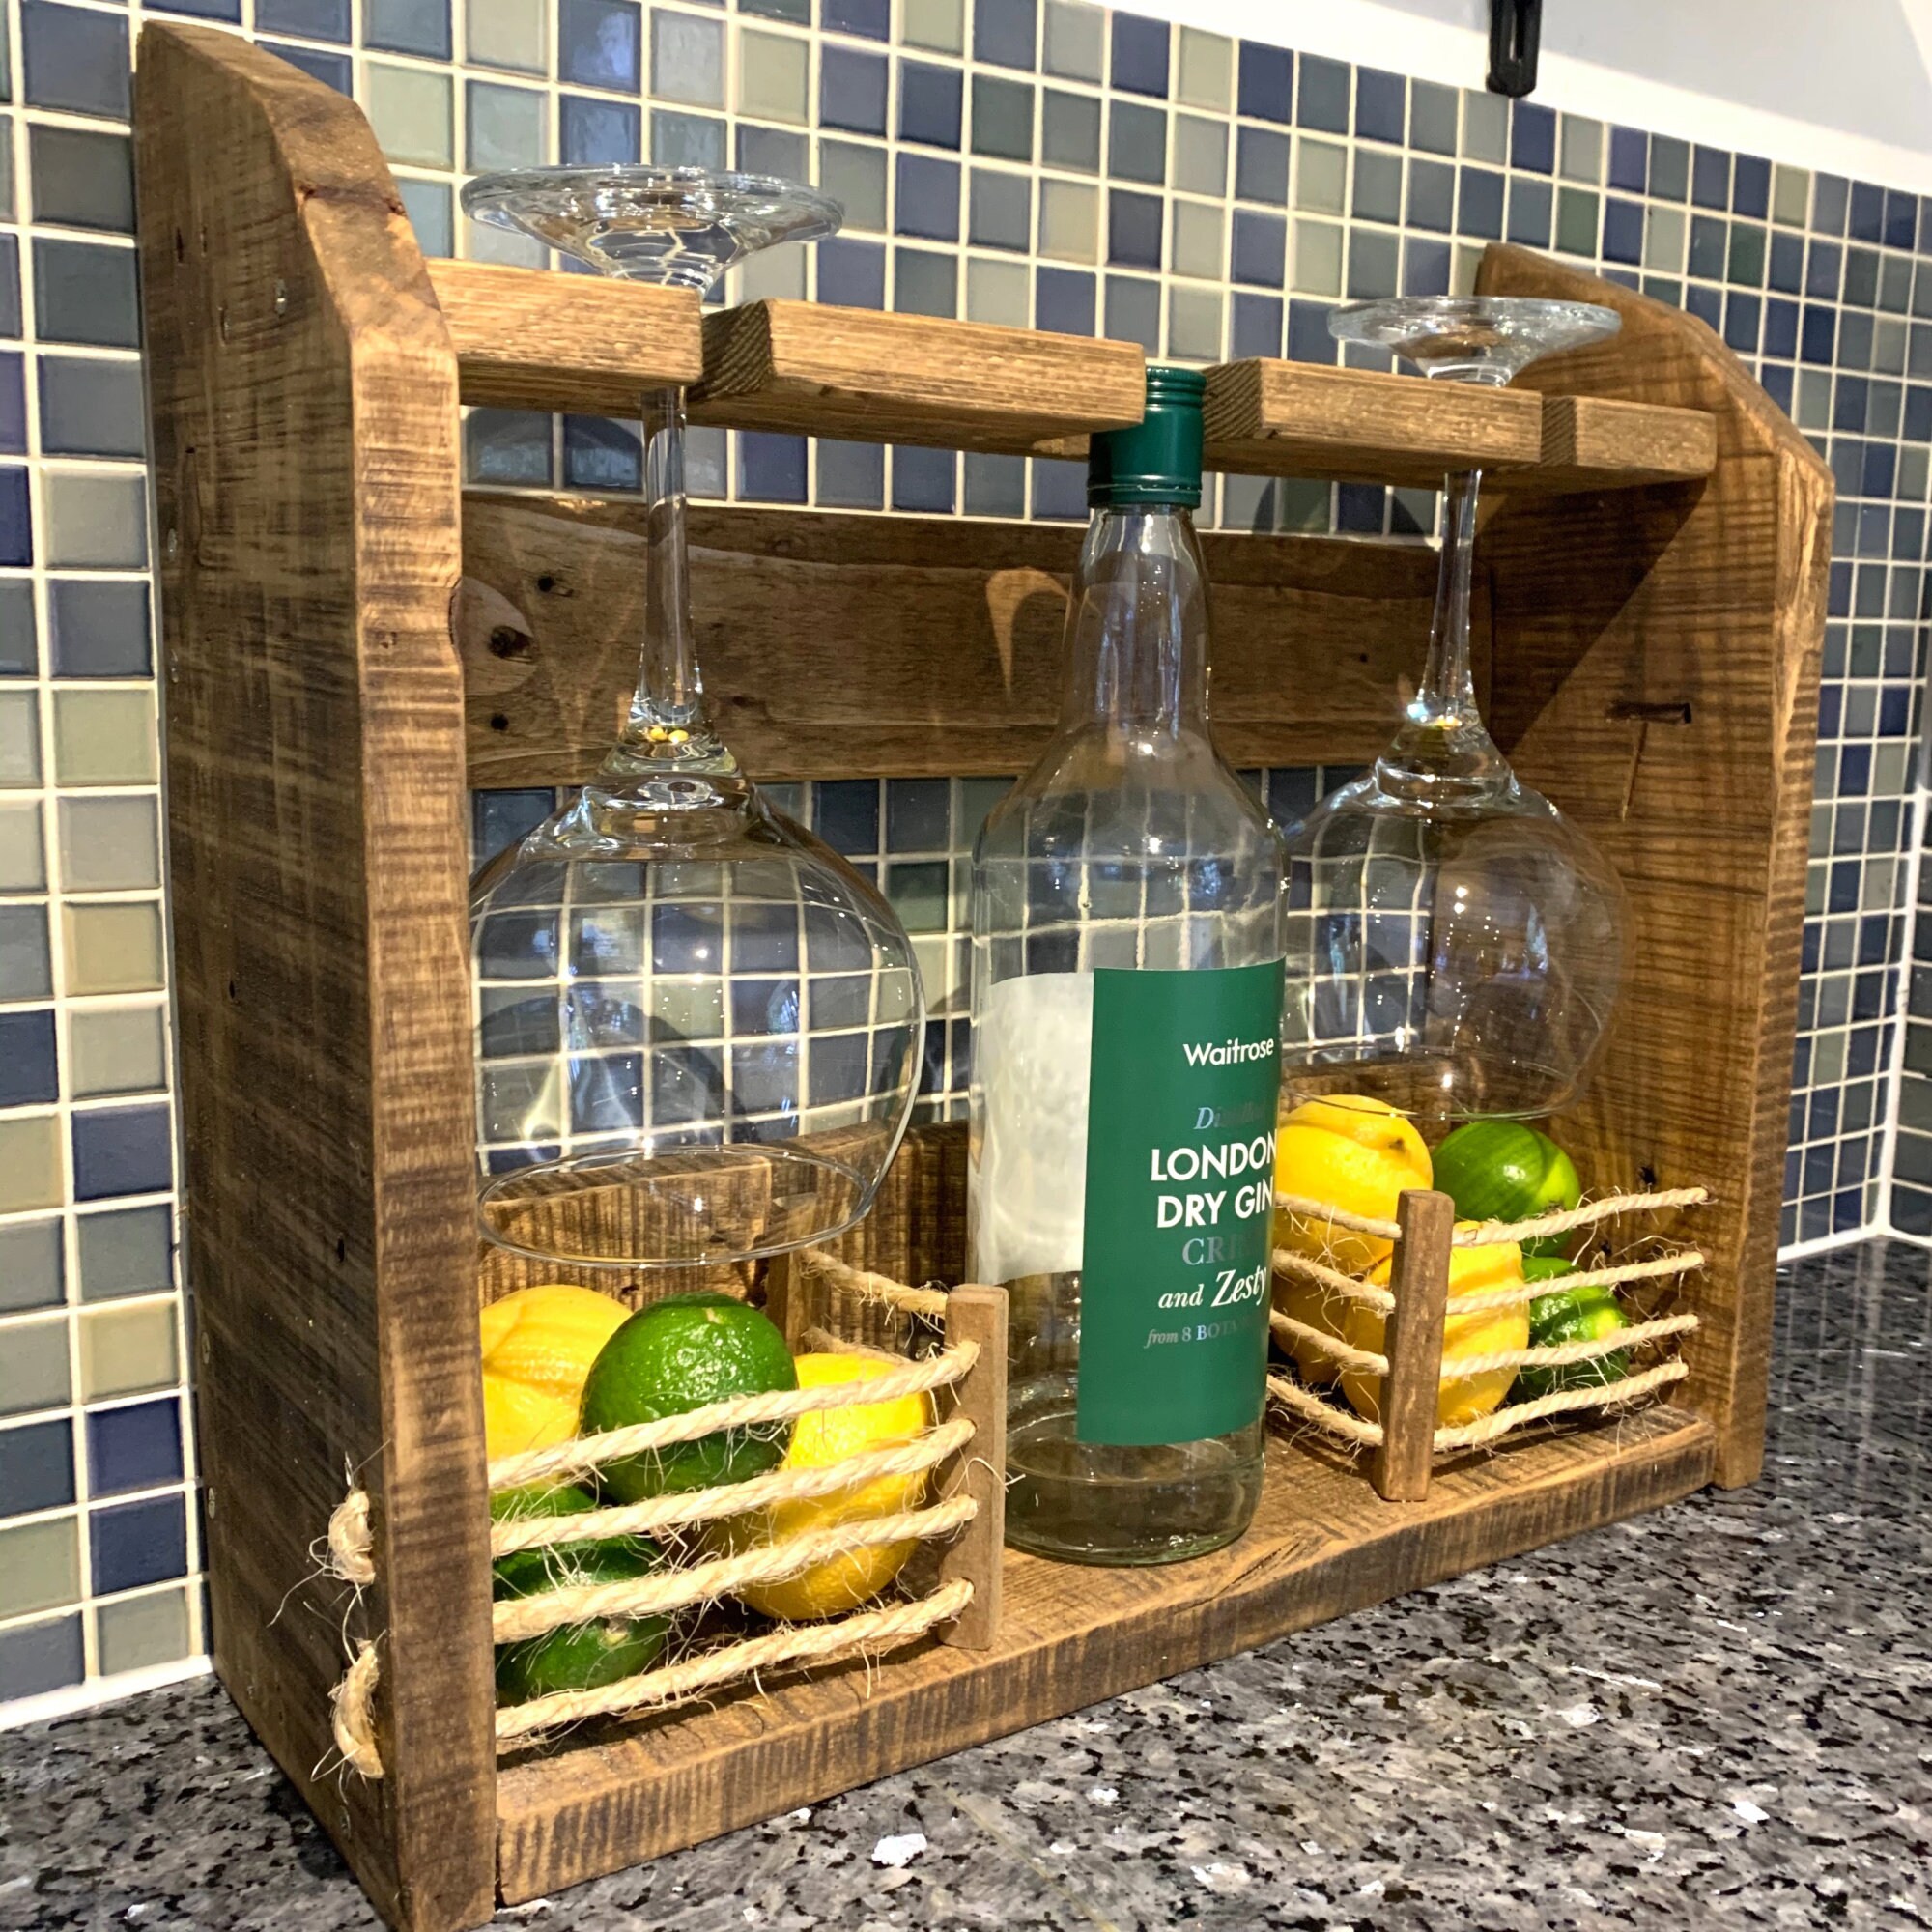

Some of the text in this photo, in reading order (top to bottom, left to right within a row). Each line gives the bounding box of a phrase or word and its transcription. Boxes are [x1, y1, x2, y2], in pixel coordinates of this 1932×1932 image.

[1183, 1037, 1274, 1066] Waitrose
[1151, 1128, 1277, 1180] LONDON
[1156, 1175, 1273, 1228] DRY GIN
[1158, 1264, 1266, 1308] and Zesty
[1143, 1328, 1179, 1349] from
[1181, 1326, 1192, 1342] 8
